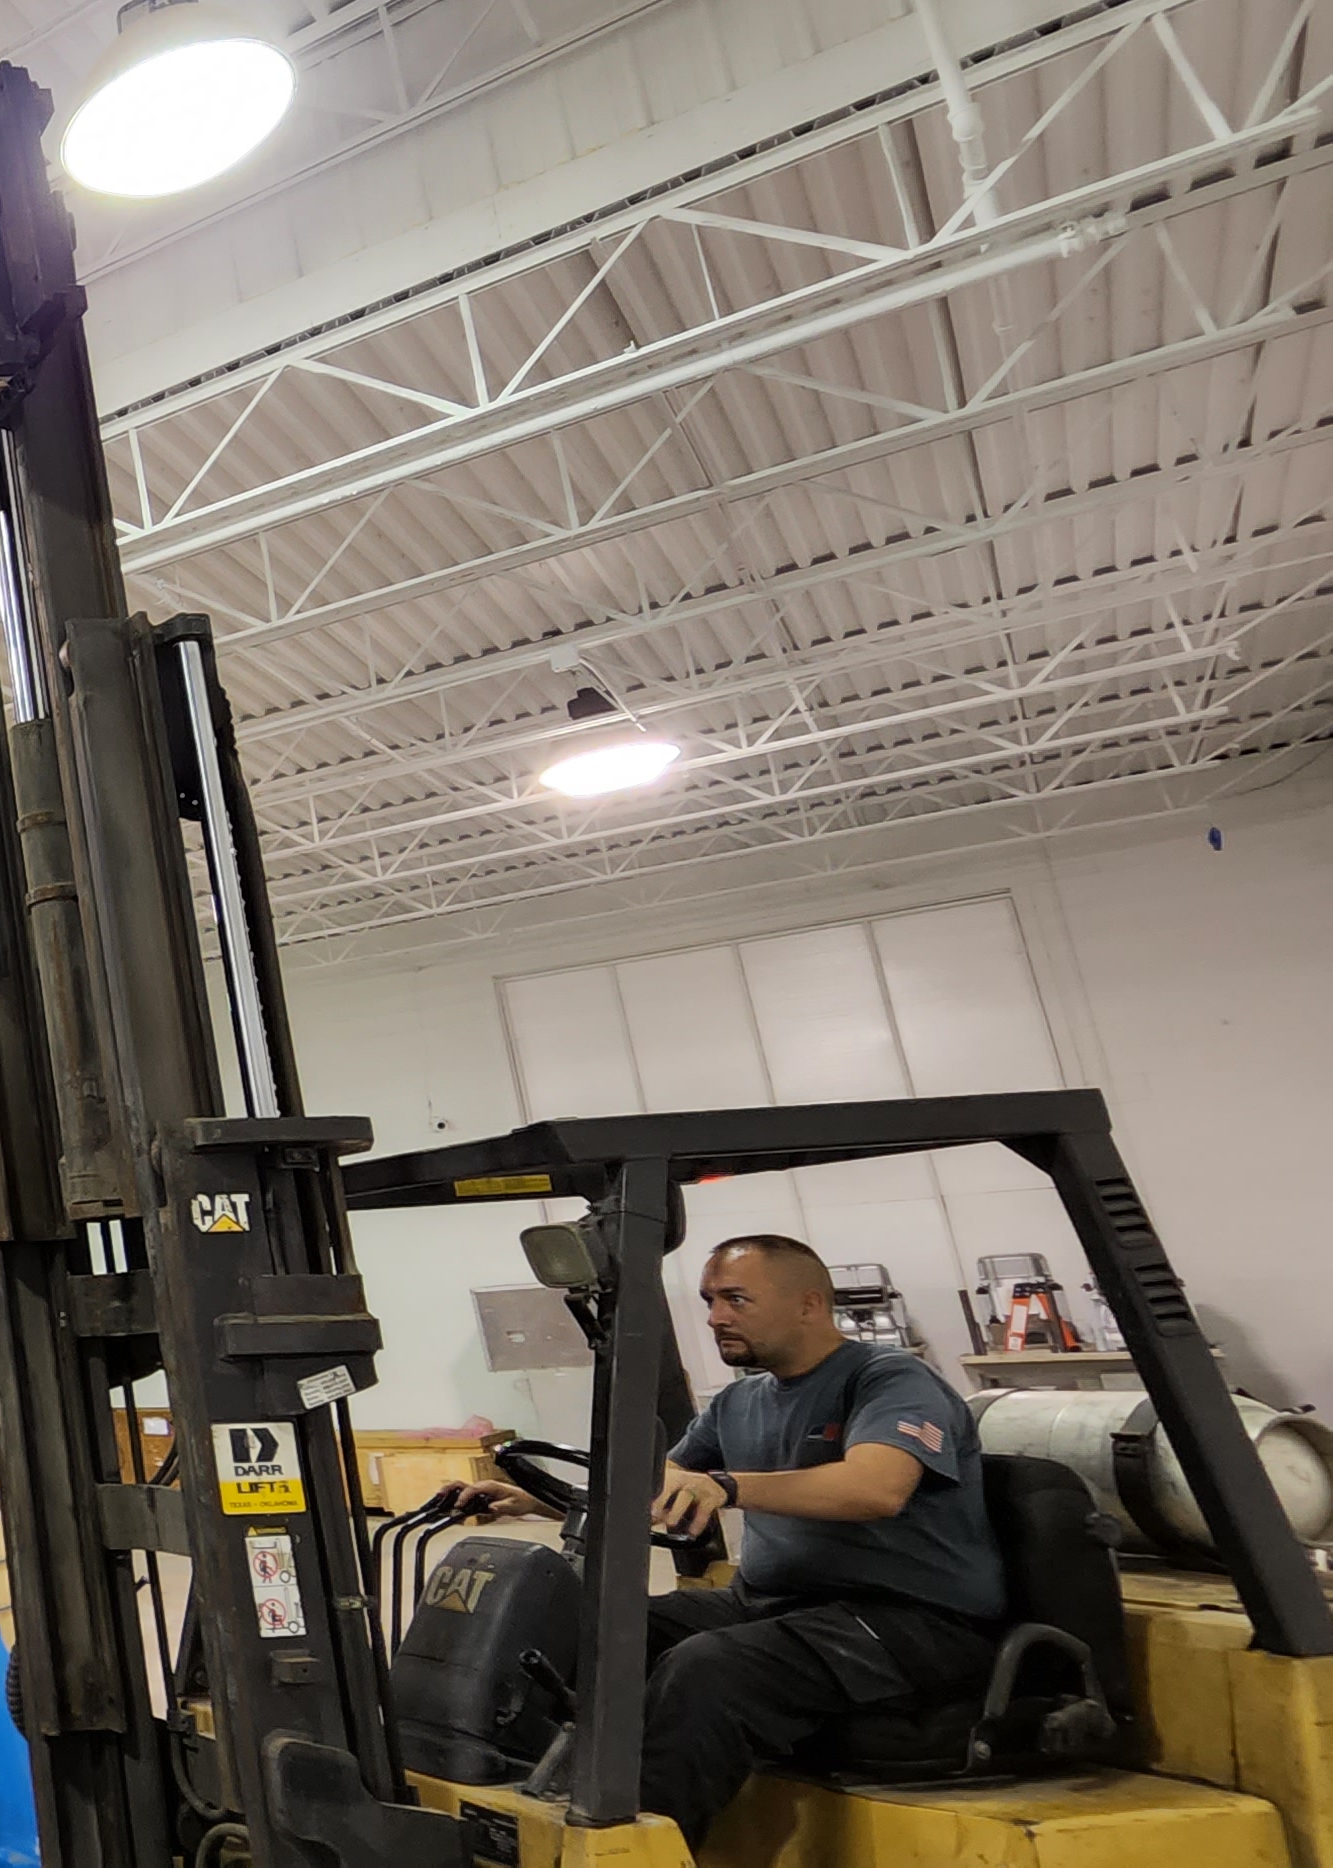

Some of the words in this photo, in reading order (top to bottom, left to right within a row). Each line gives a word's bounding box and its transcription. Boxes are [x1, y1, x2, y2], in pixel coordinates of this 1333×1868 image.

[191, 1193, 251, 1233] CAT
[234, 1465, 284, 1476] DARR
[229, 1501, 252, 1509] TEXAS
[259, 1500, 299, 1508] OKLAHOMA
[425, 1565, 497, 1614] CAT
